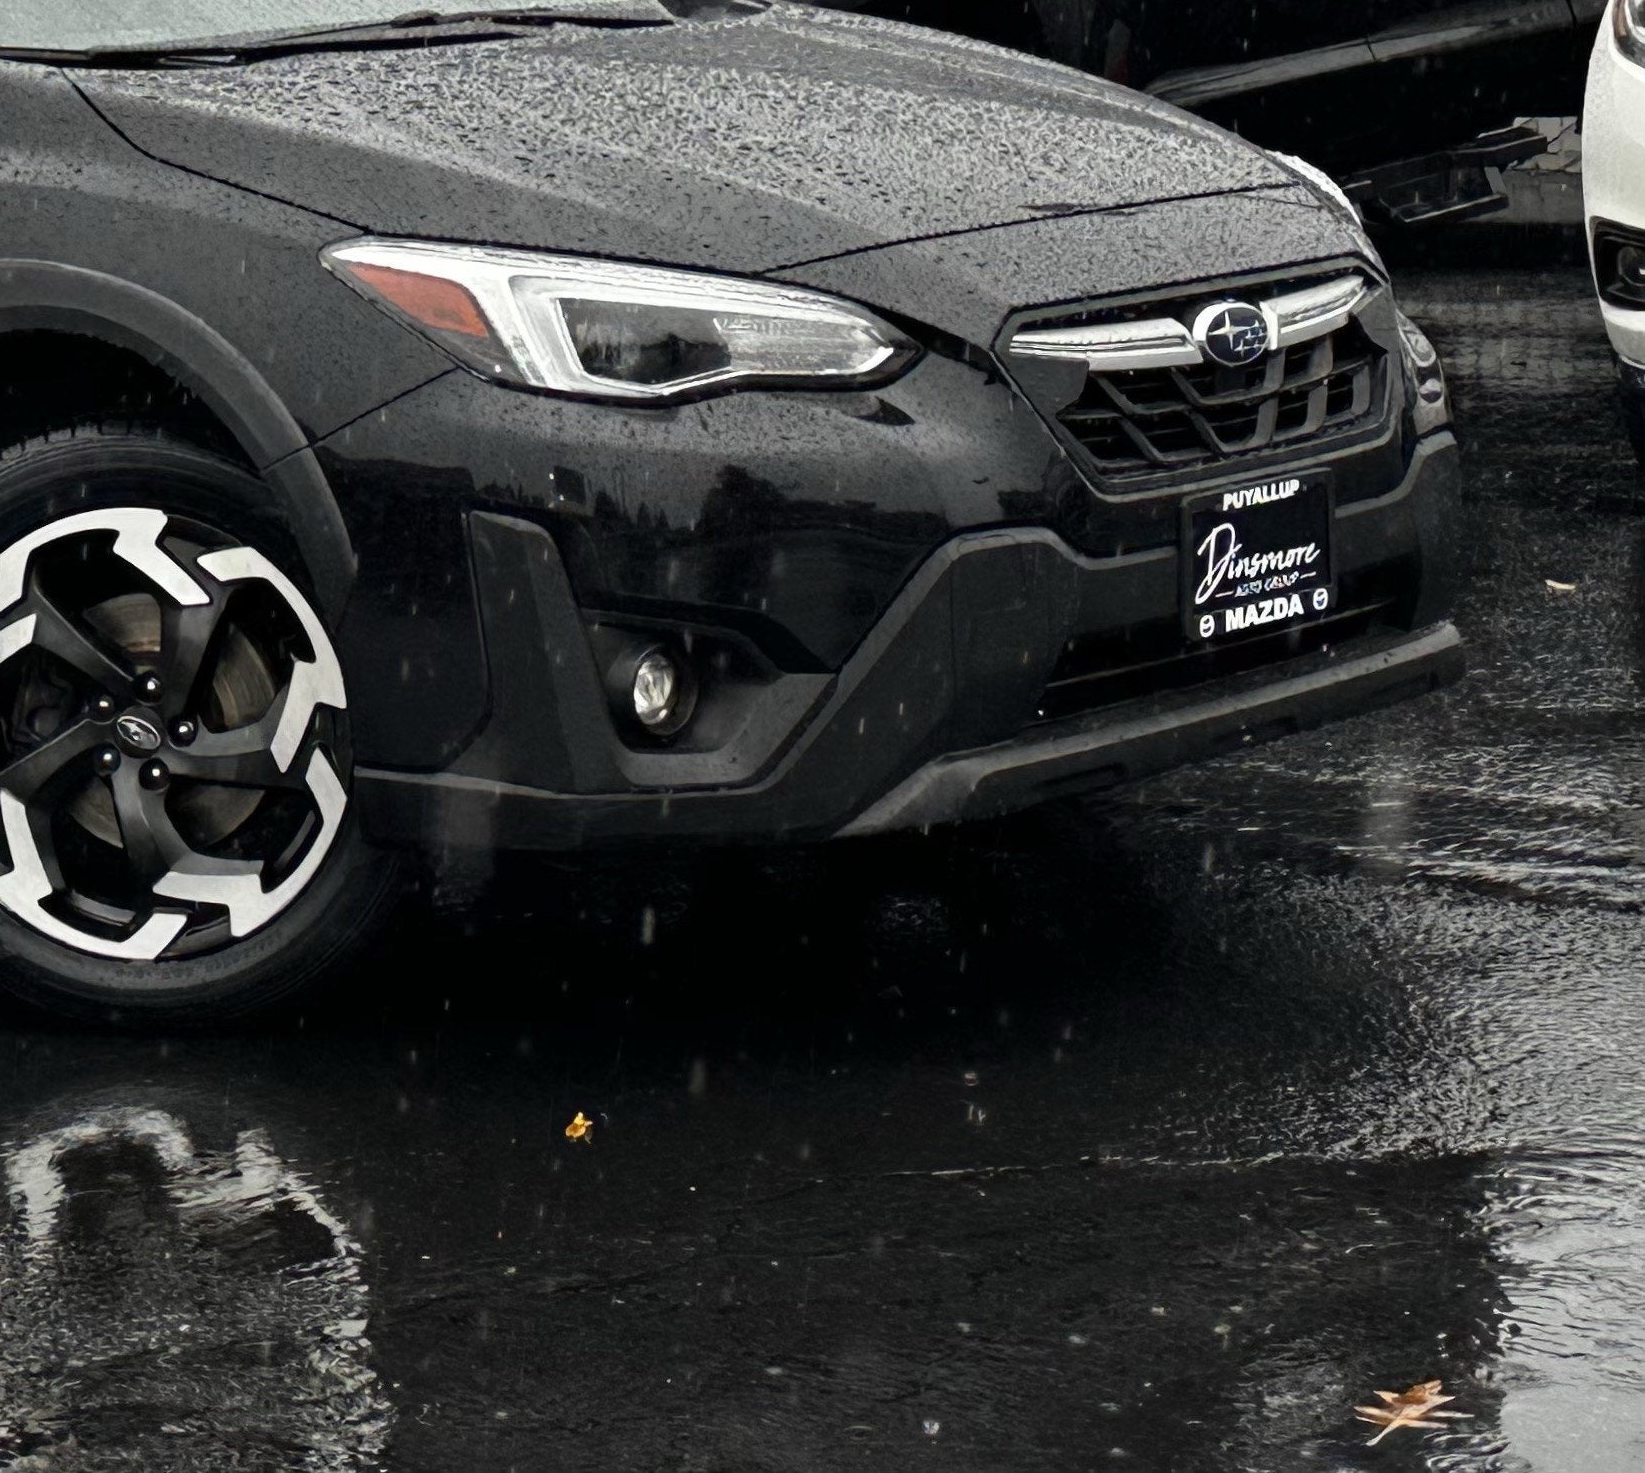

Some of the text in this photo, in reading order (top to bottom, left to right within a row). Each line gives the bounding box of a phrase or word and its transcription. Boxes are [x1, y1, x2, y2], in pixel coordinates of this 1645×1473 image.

[1222, 479, 1300, 511] PUYALLUP
[1194, 523, 1321, 604] Dinsmore
[1225, 594, 1304, 633] MAZDA
